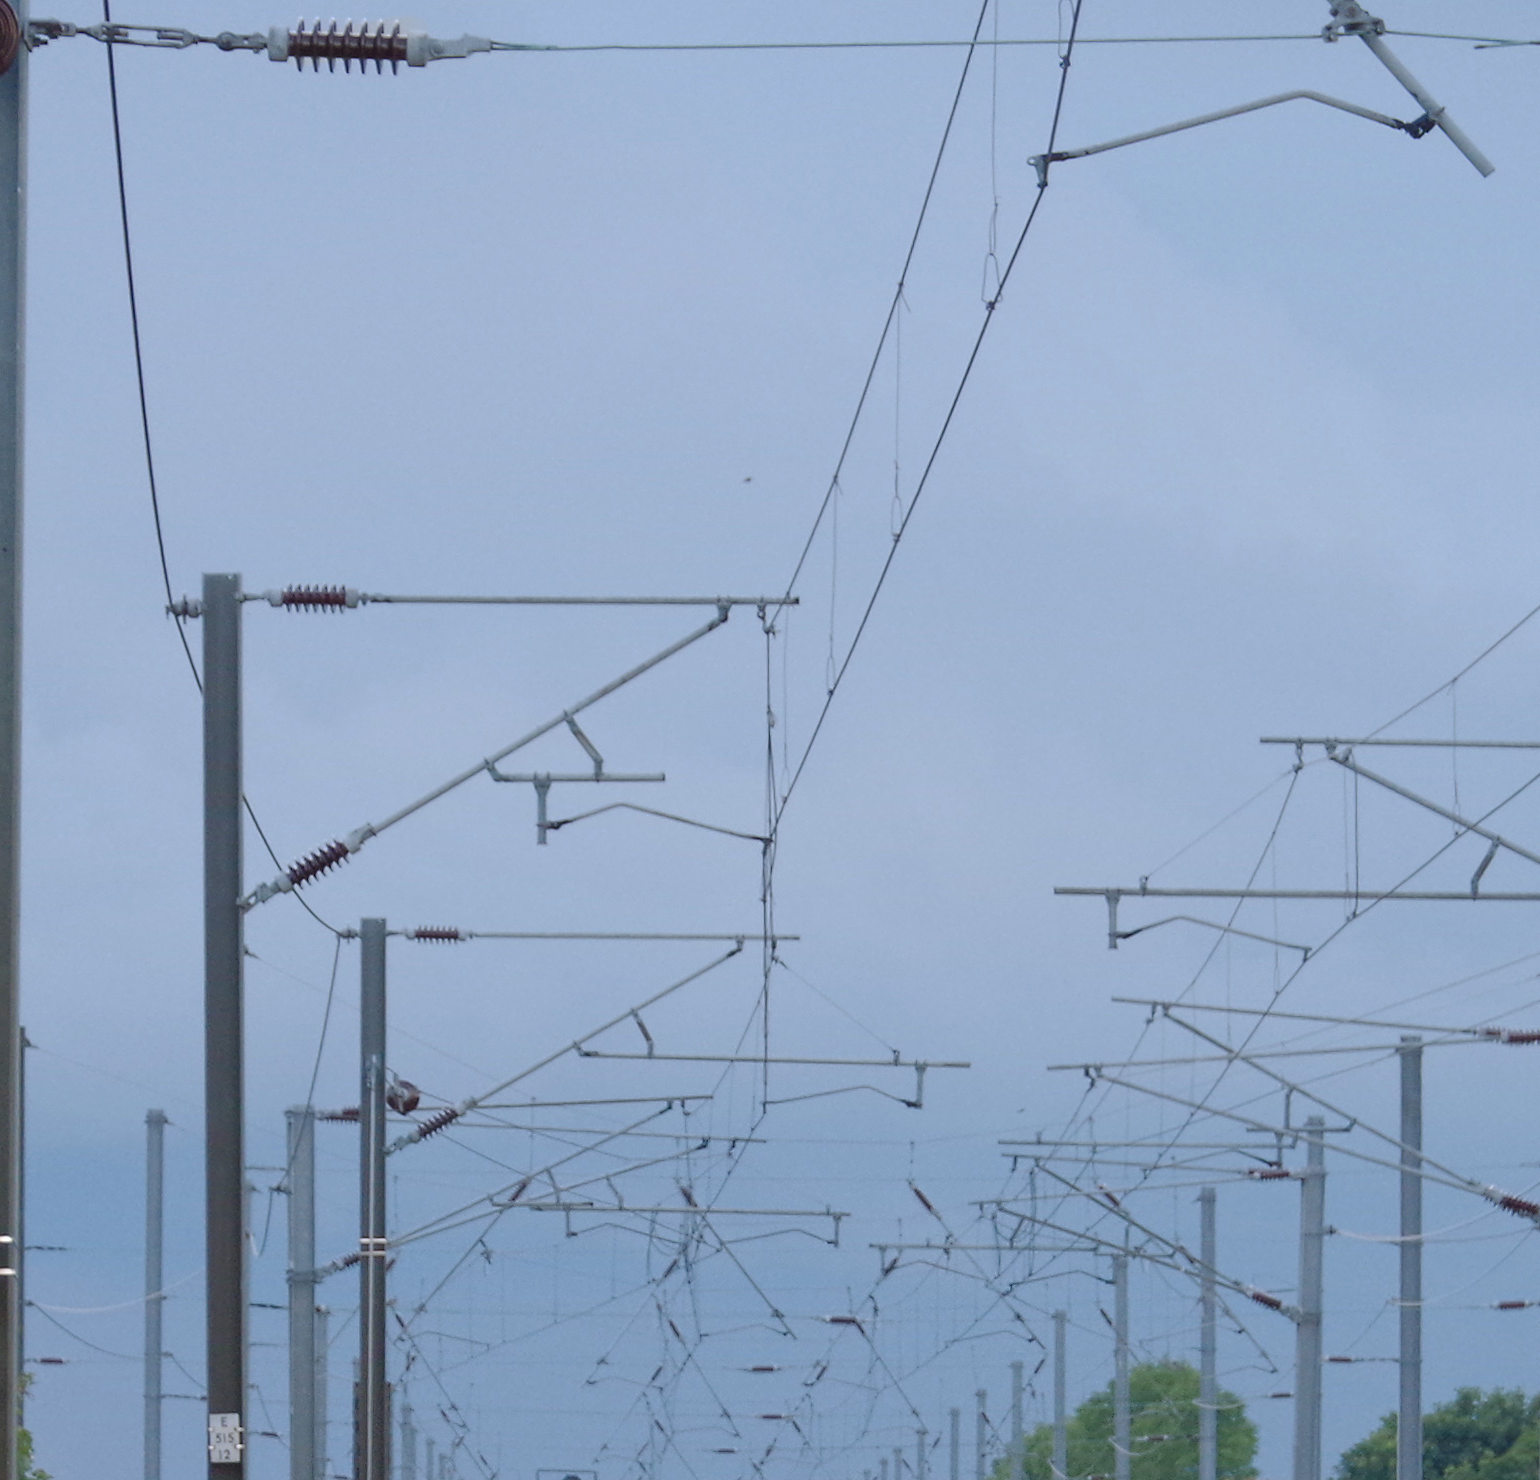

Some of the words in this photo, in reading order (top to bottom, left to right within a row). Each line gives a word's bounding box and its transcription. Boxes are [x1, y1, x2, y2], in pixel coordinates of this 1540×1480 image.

[221, 1416, 228, 1428] E
[216, 1432, 235, 1444] 515
[219, 1449, 231, 1460] 12
